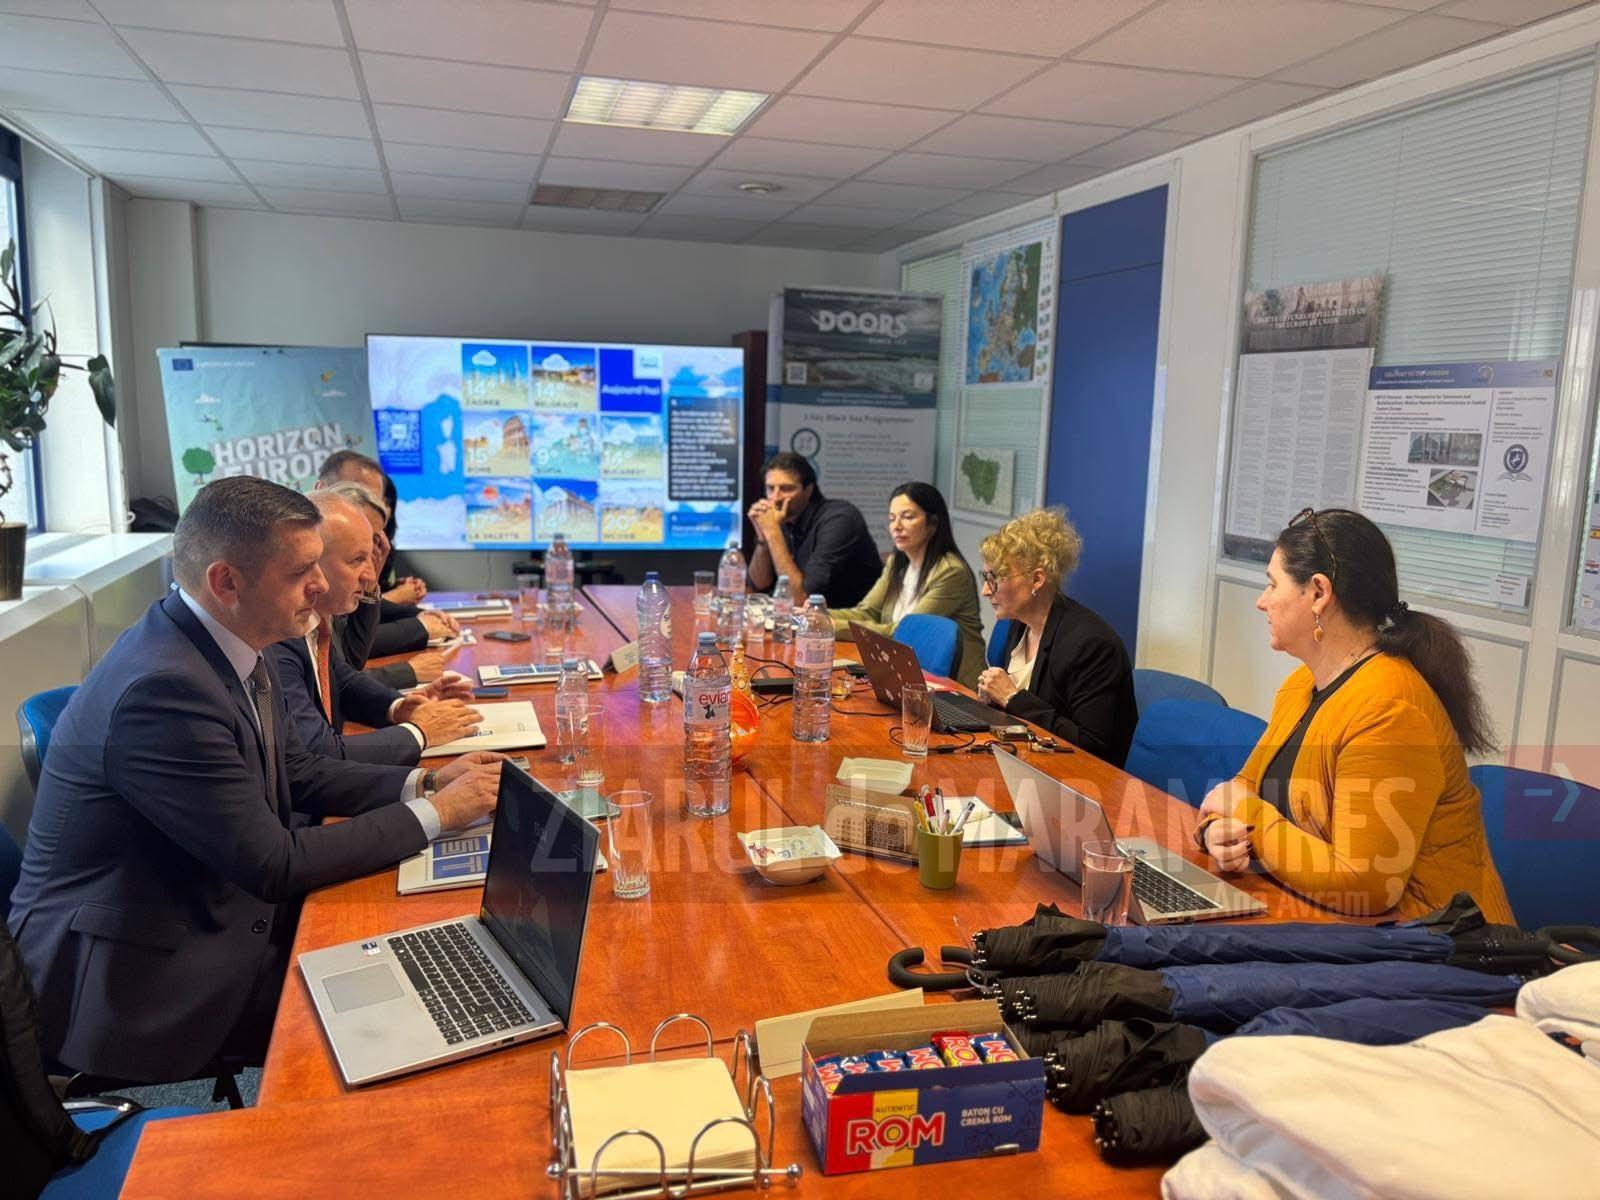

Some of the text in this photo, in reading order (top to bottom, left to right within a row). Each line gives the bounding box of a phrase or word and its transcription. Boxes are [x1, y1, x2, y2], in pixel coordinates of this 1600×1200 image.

[811, 309, 907, 338] DOORS
[213, 423, 344, 467] HORIZON
[222, 446, 348, 485] EUROP
[875, 1103, 917, 1113] AUTENTIC
[961, 1106, 1004, 1118] BATON CU
[992, 1114, 1012, 1124] ROM
[847, 1111, 946, 1155] ROM
